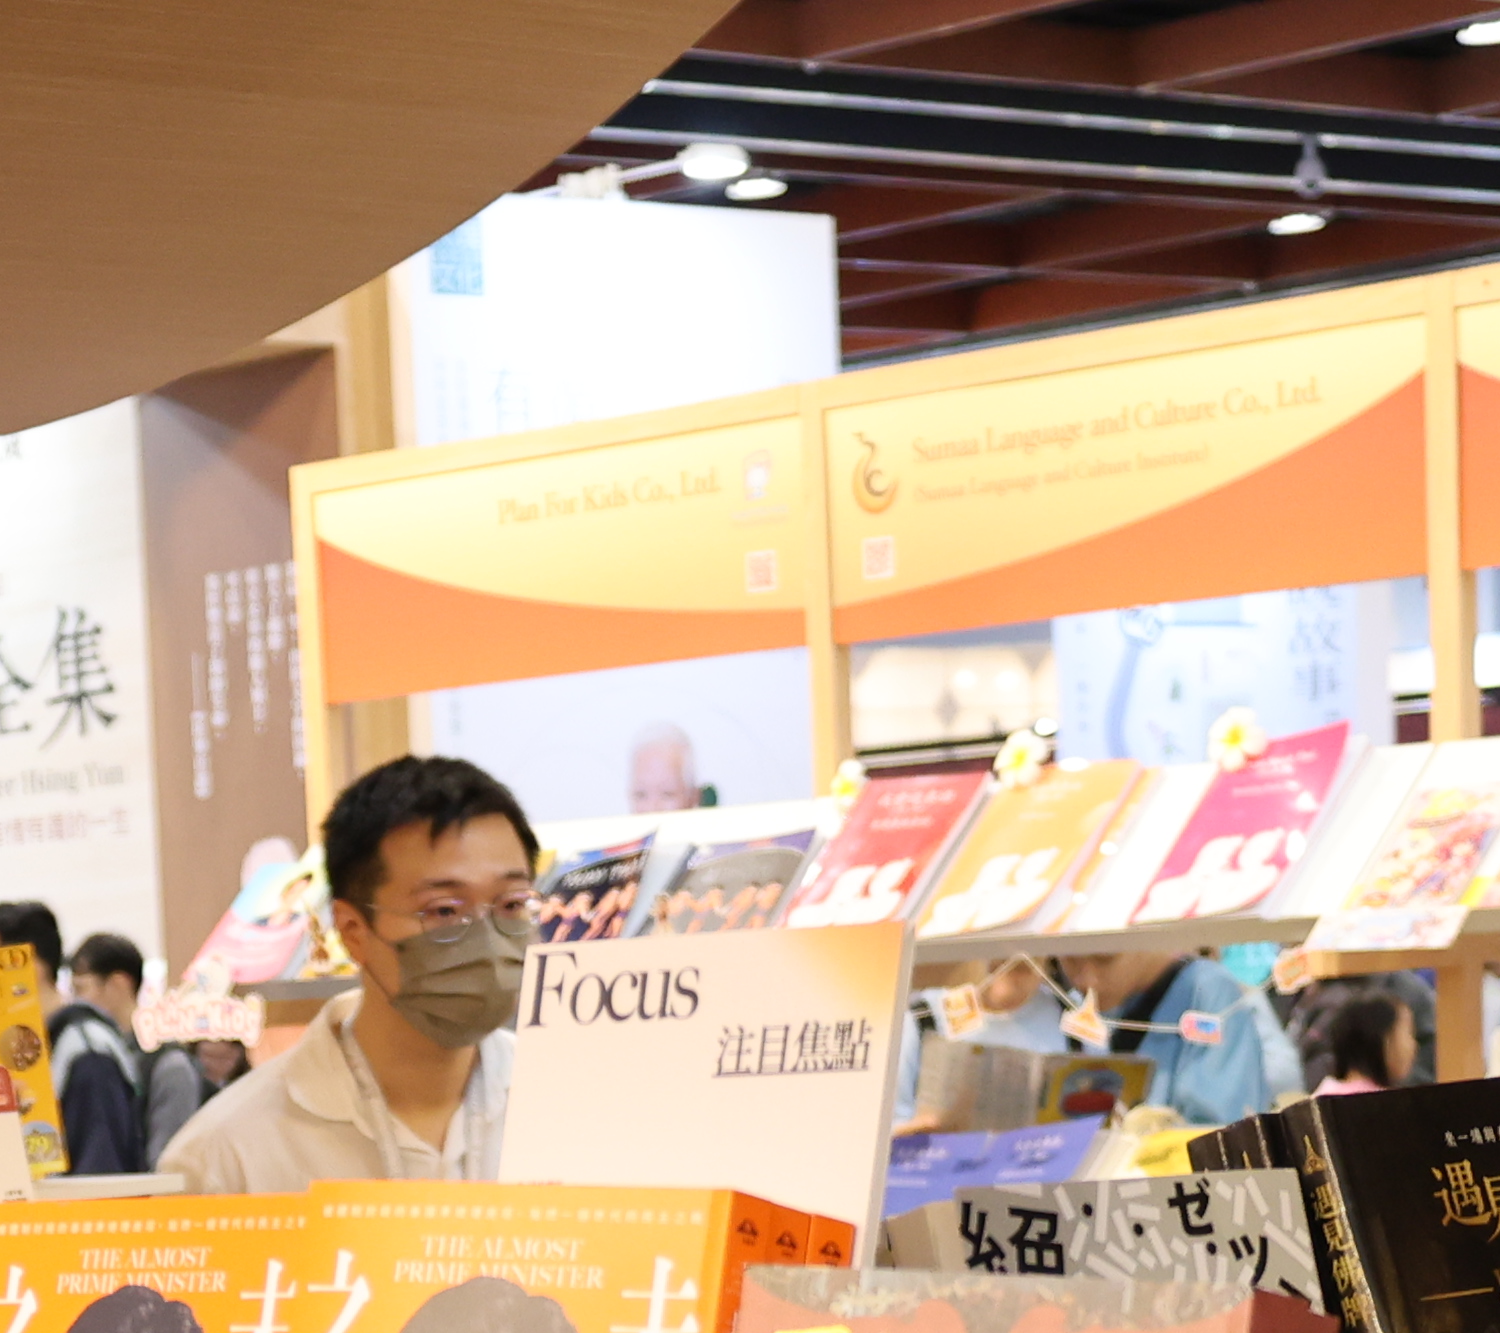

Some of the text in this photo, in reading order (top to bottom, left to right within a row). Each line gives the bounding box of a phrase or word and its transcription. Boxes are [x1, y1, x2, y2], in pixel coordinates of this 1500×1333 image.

[986, 420, 1084, 460] Language
[1090, 407, 1129, 437] and
[1135, 396, 1217, 432] Culture
[526, 950, 700, 1027] Focus
[714, 1019, 872, 1076] 注目焦點
[80, 1245, 211, 1270] THE ALMOST
[423, 1235, 585, 1261] THE ALMOST
[1311, 1182, 1373, 1330] 遇見佛牌
[56, 1268, 227, 1296] PRIME MINISTER
[394, 1262, 462, 1288] PRIME
